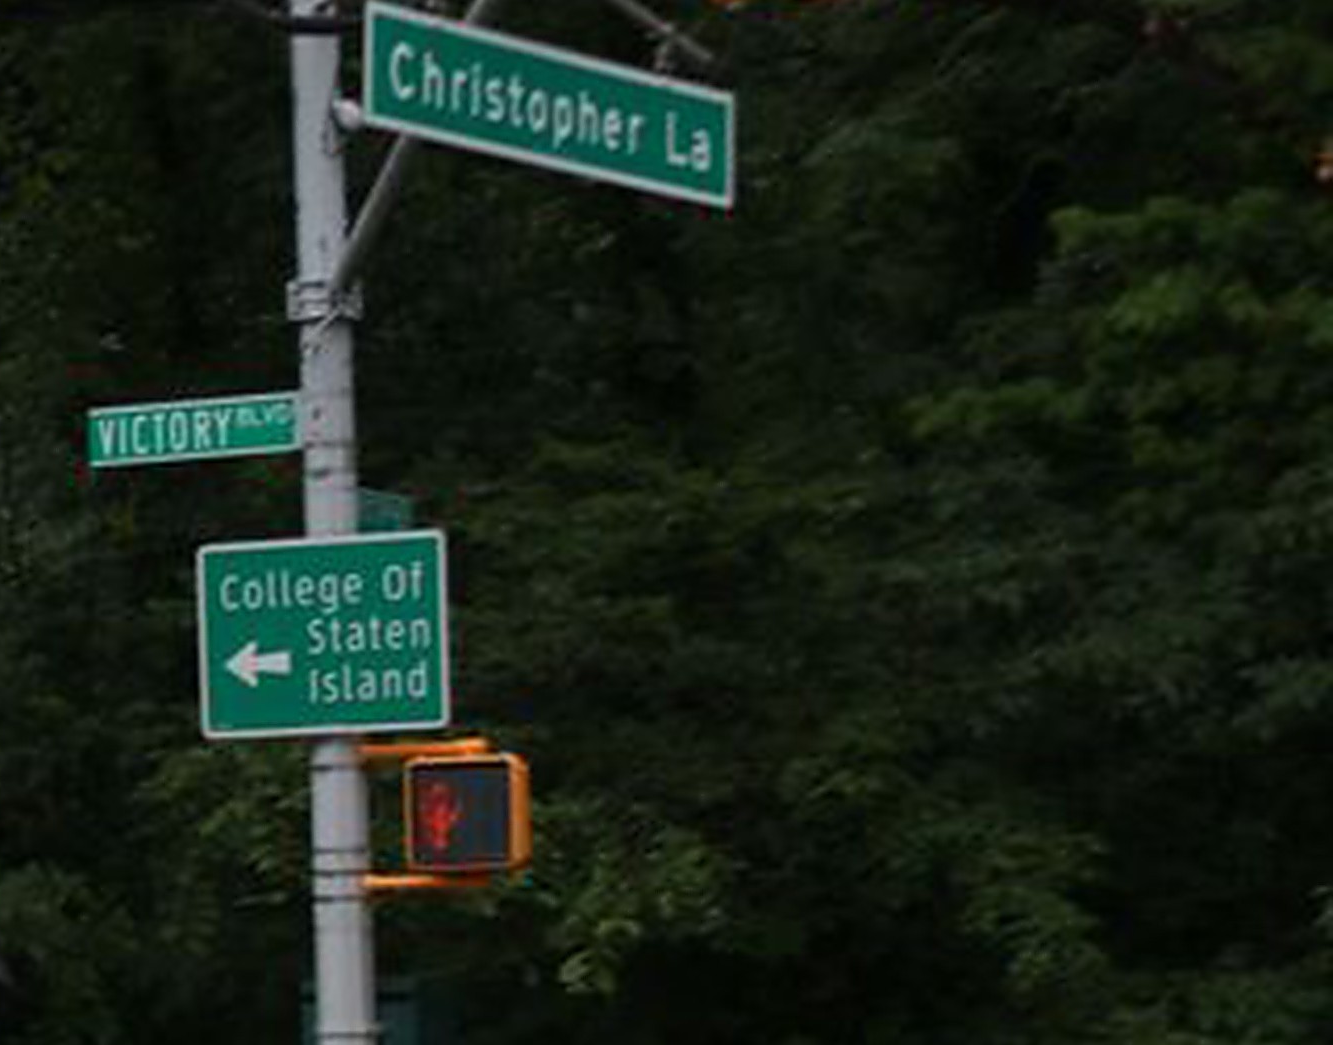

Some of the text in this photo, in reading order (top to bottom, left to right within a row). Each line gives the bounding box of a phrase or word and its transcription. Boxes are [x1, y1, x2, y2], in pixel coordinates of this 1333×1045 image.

[388, 41, 712, 172] Christopher La
[98, 402, 290, 456] VICTORY BLVD
[219, 561, 424, 616] College Of
[307, 615, 432, 655] Staten
[309, 659, 428, 704] Island
